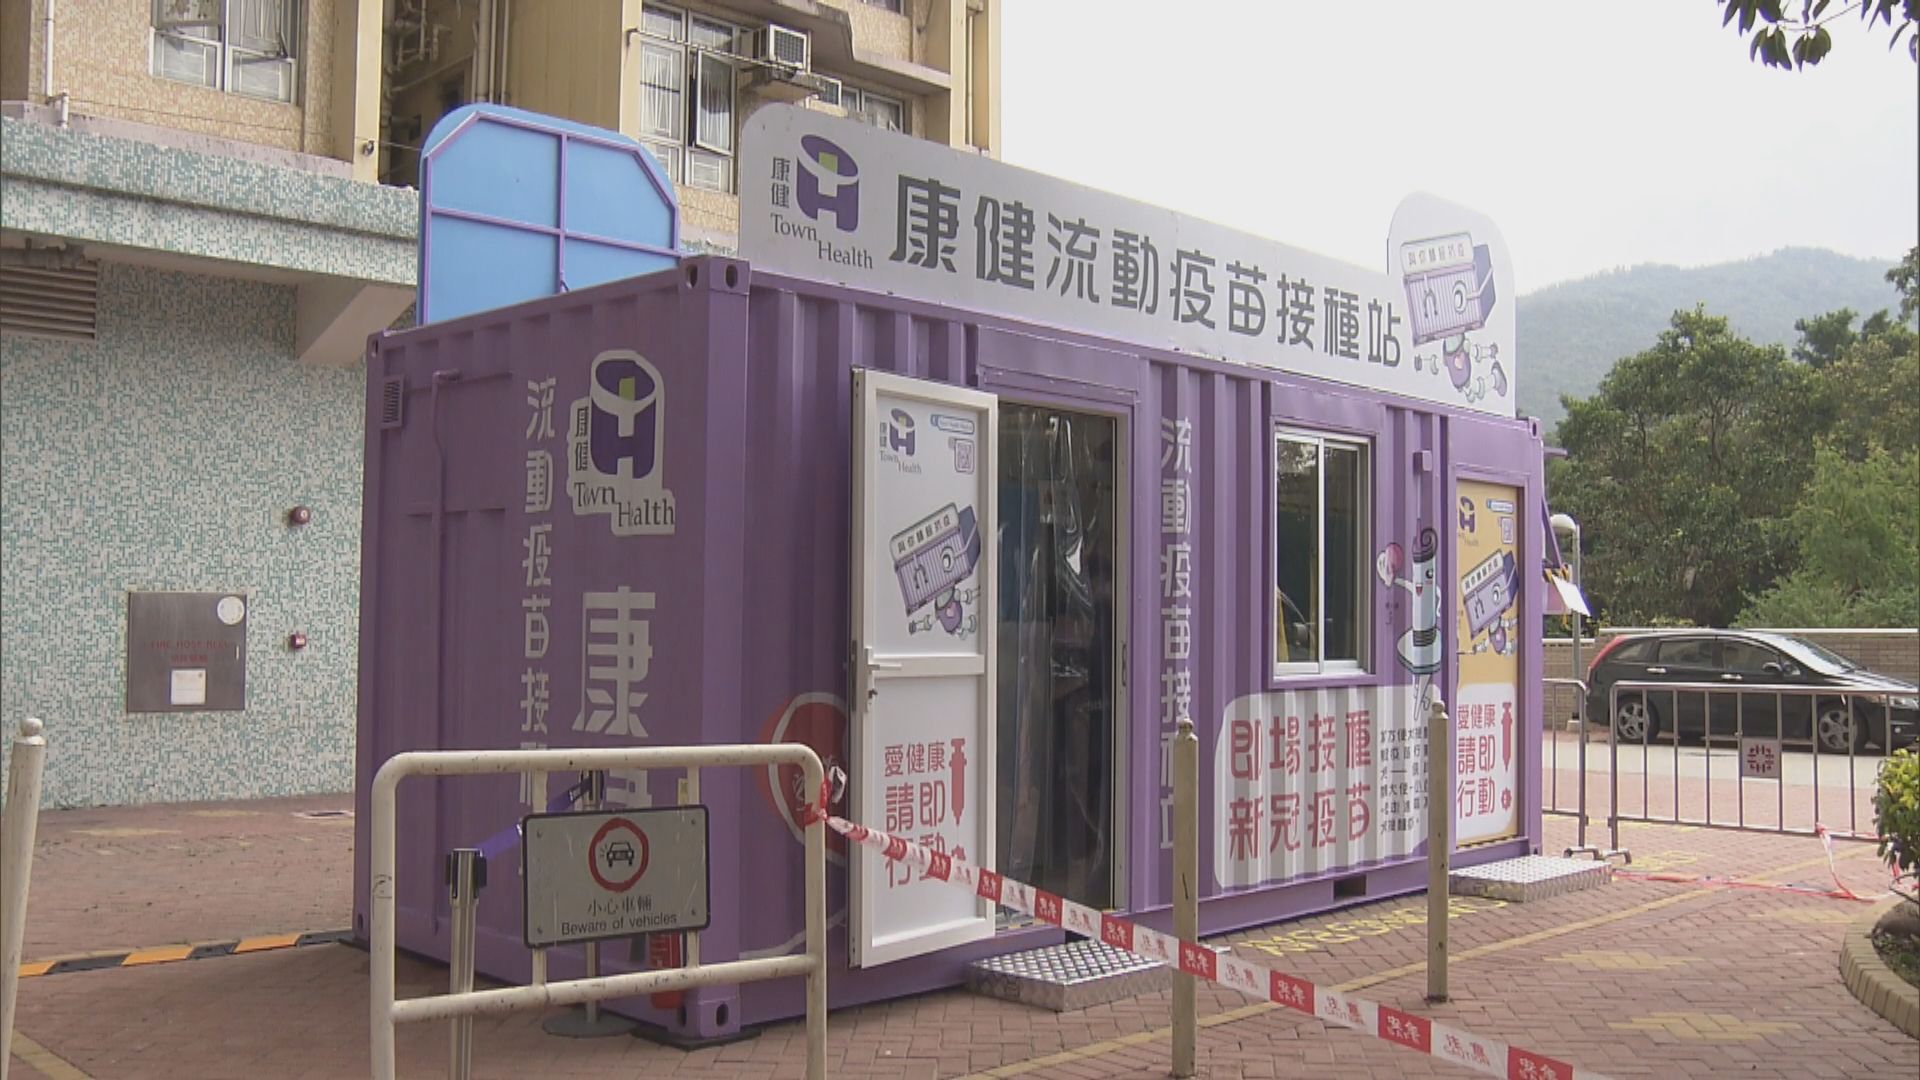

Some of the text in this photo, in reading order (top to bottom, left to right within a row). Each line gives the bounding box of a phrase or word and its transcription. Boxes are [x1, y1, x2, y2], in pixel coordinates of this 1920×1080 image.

[771, 156, 790, 208] 康健
[770, 213, 817, 242] Town
[818, 239, 873, 269] Health
[889, 174, 1401, 368] 康健流動疫苗接種站
[617, 499, 675, 527] Halth
[1458, 704, 1496, 730] 愛健康
[884, 741, 945, 777] 愛健康
[1231, 710, 1371, 781] 即場接種
[1458, 734, 1496, 774] 請即
[885, 780, 946, 833] 請即
[1457, 776, 1496, 819] 行動
[1229, 781, 1372, 861] 新冠疫苗
[561, 912, 677, 936] Beware of vehicles
